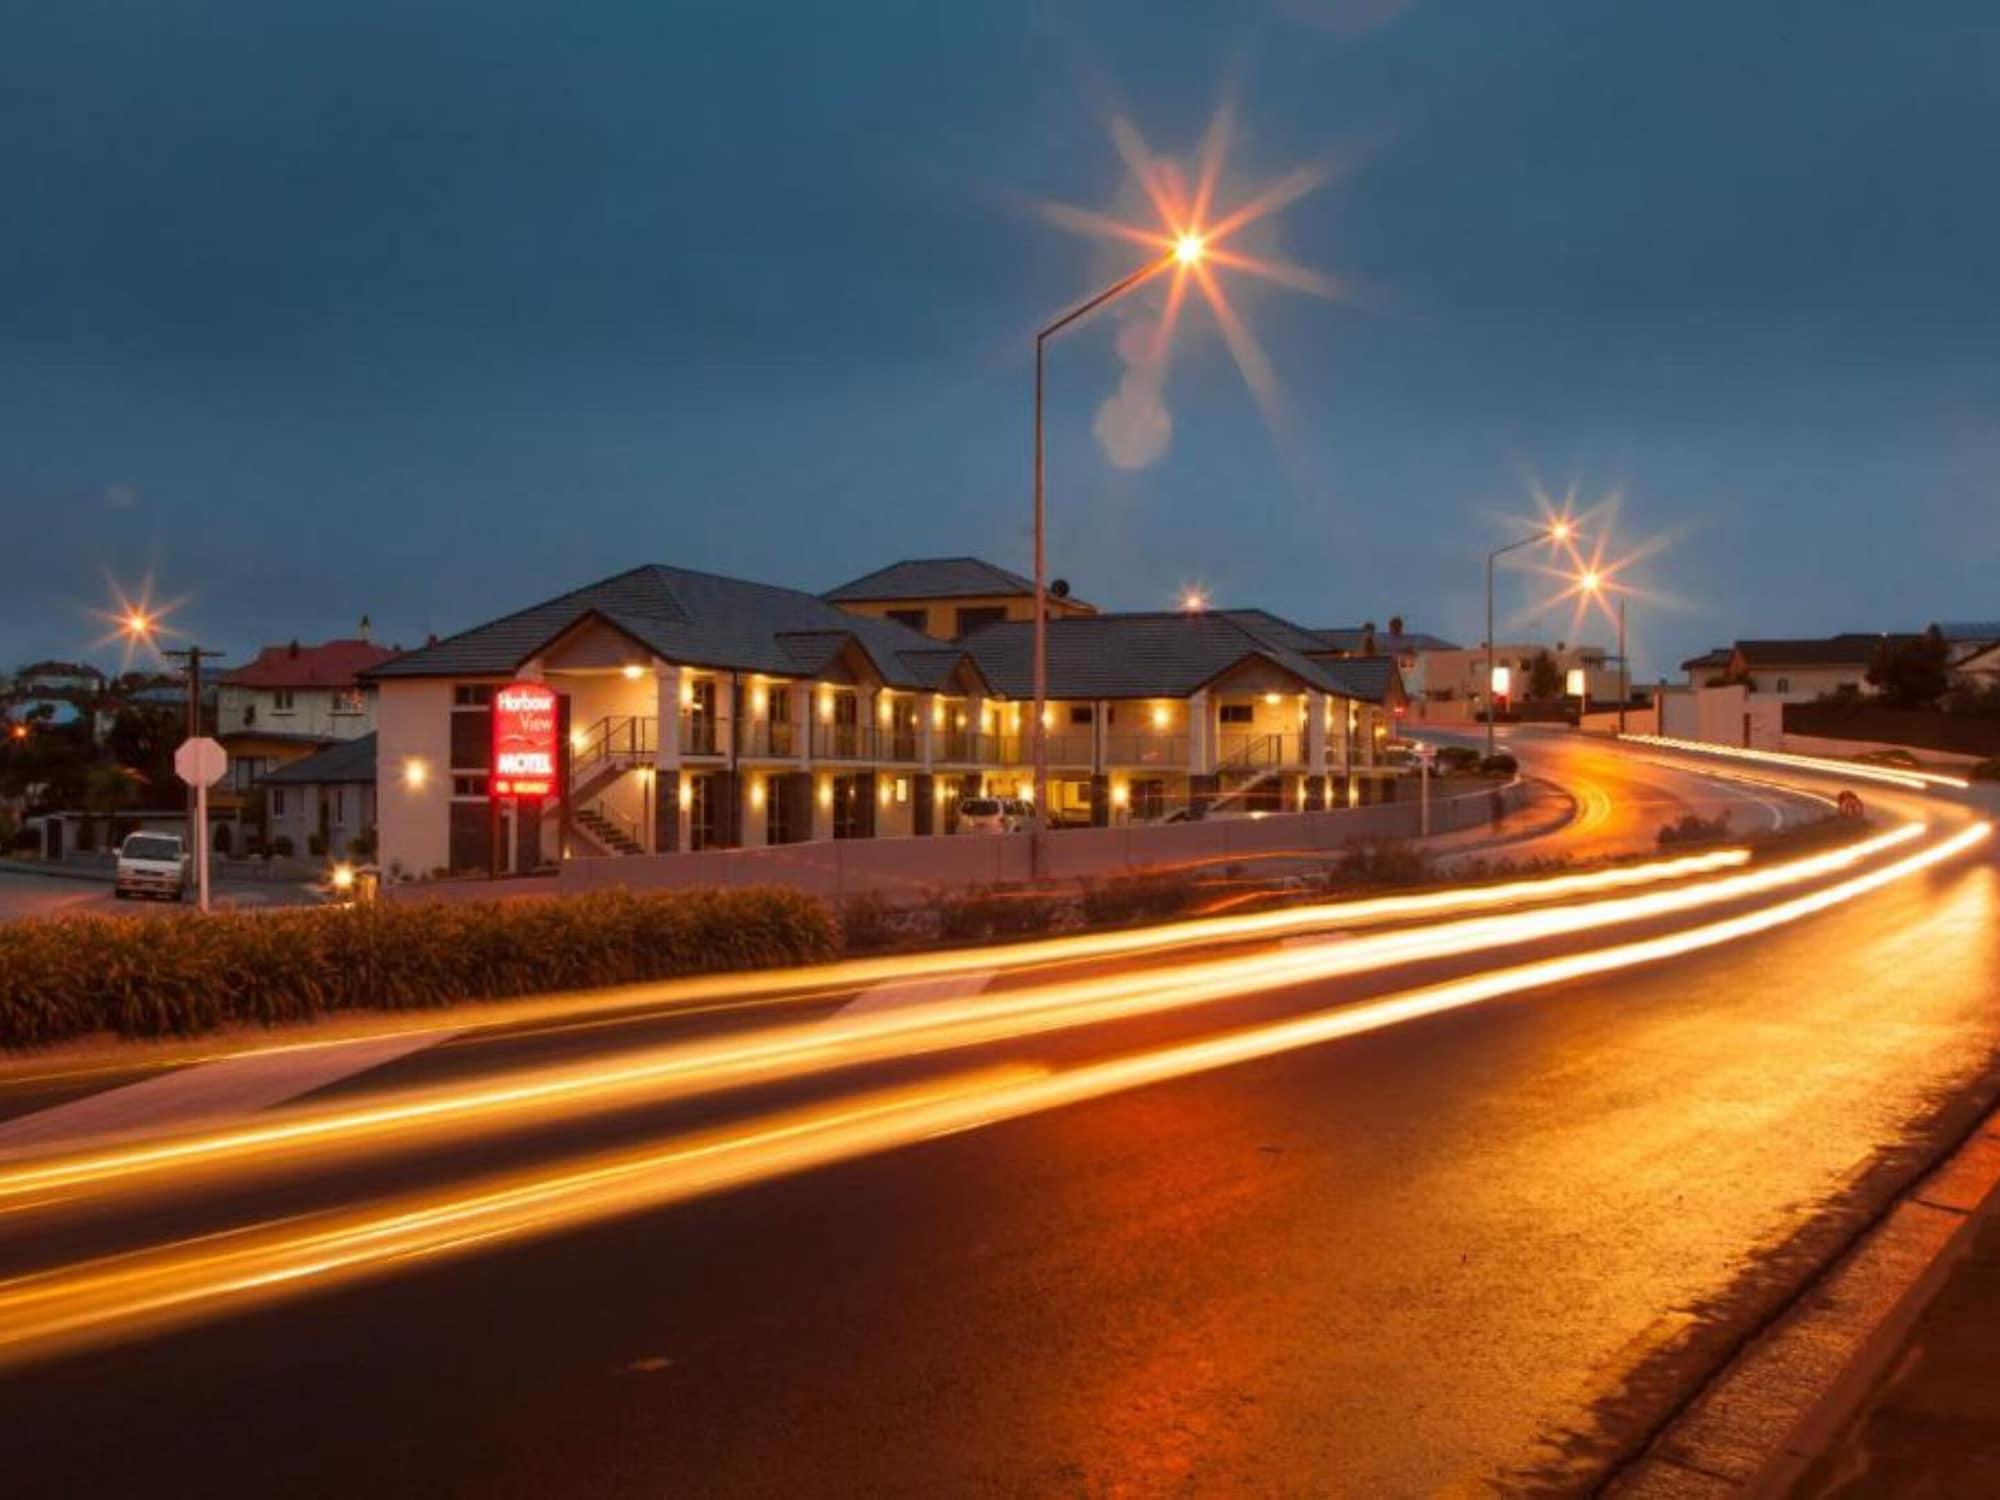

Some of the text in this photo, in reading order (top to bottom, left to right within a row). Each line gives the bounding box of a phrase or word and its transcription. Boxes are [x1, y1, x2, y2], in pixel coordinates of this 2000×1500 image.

[497, 691, 553, 711] Harbour
[520, 712, 553, 733] View
[498, 753, 553, 774] MOTEL
